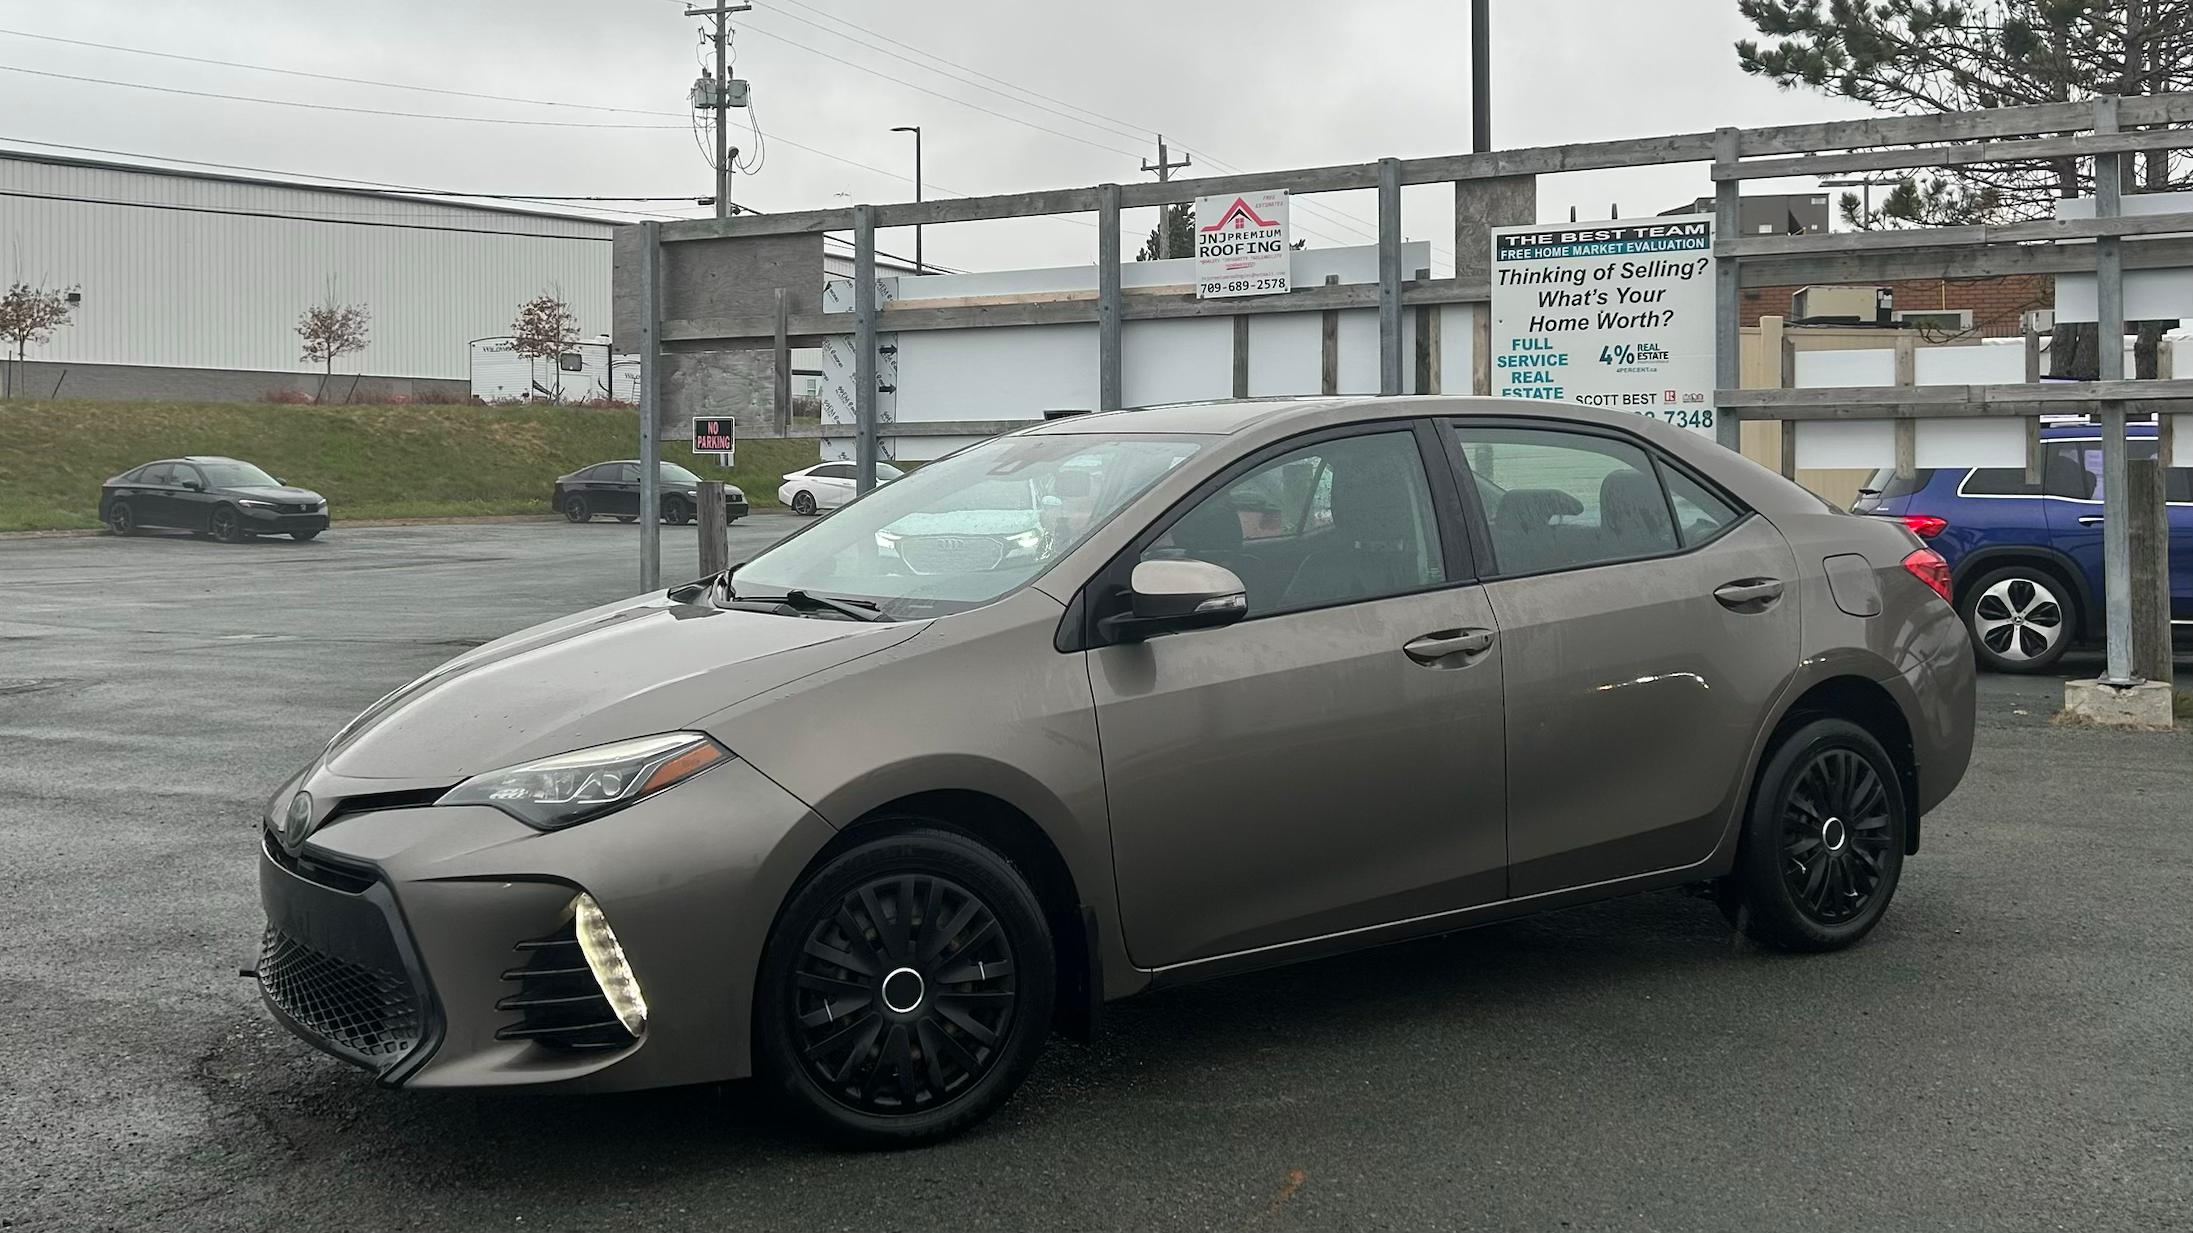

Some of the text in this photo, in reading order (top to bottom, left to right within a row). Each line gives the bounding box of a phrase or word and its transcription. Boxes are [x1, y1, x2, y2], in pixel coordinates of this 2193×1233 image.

[1505, 224, 1705, 246] THE BEST TEAM
[1199, 240, 1282, 258] ROOFING
[1500, 238, 1705, 260] FREE HOME MARKET EVALUATION
[1498, 258, 1709, 286] Thinking of Selling?
[1200, 278, 1286, 294] 709-689-2578
[1538, 287, 1667, 308] What's Your
[1529, 309, 1674, 333] Home Worth?
[1512, 338, 1553, 351] FULL
[1637, 343, 1660, 352] REAL
[1497, 353, 1569, 368] SERVICE
[1599, 344, 1635, 366] 4%
[1637, 351, 1669, 361] ESTATE
[1511, 370, 1555, 384] REAL
[1502, 387, 1564, 400] ESTATE
[1576, 393, 1620, 406] SCOTT
[1623, 393, 1657, 406] BEST
[1664, 410, 1714, 429] 7348
[707, 421, 719, 435] NO
[697, 435, 731, 449] PARKING
